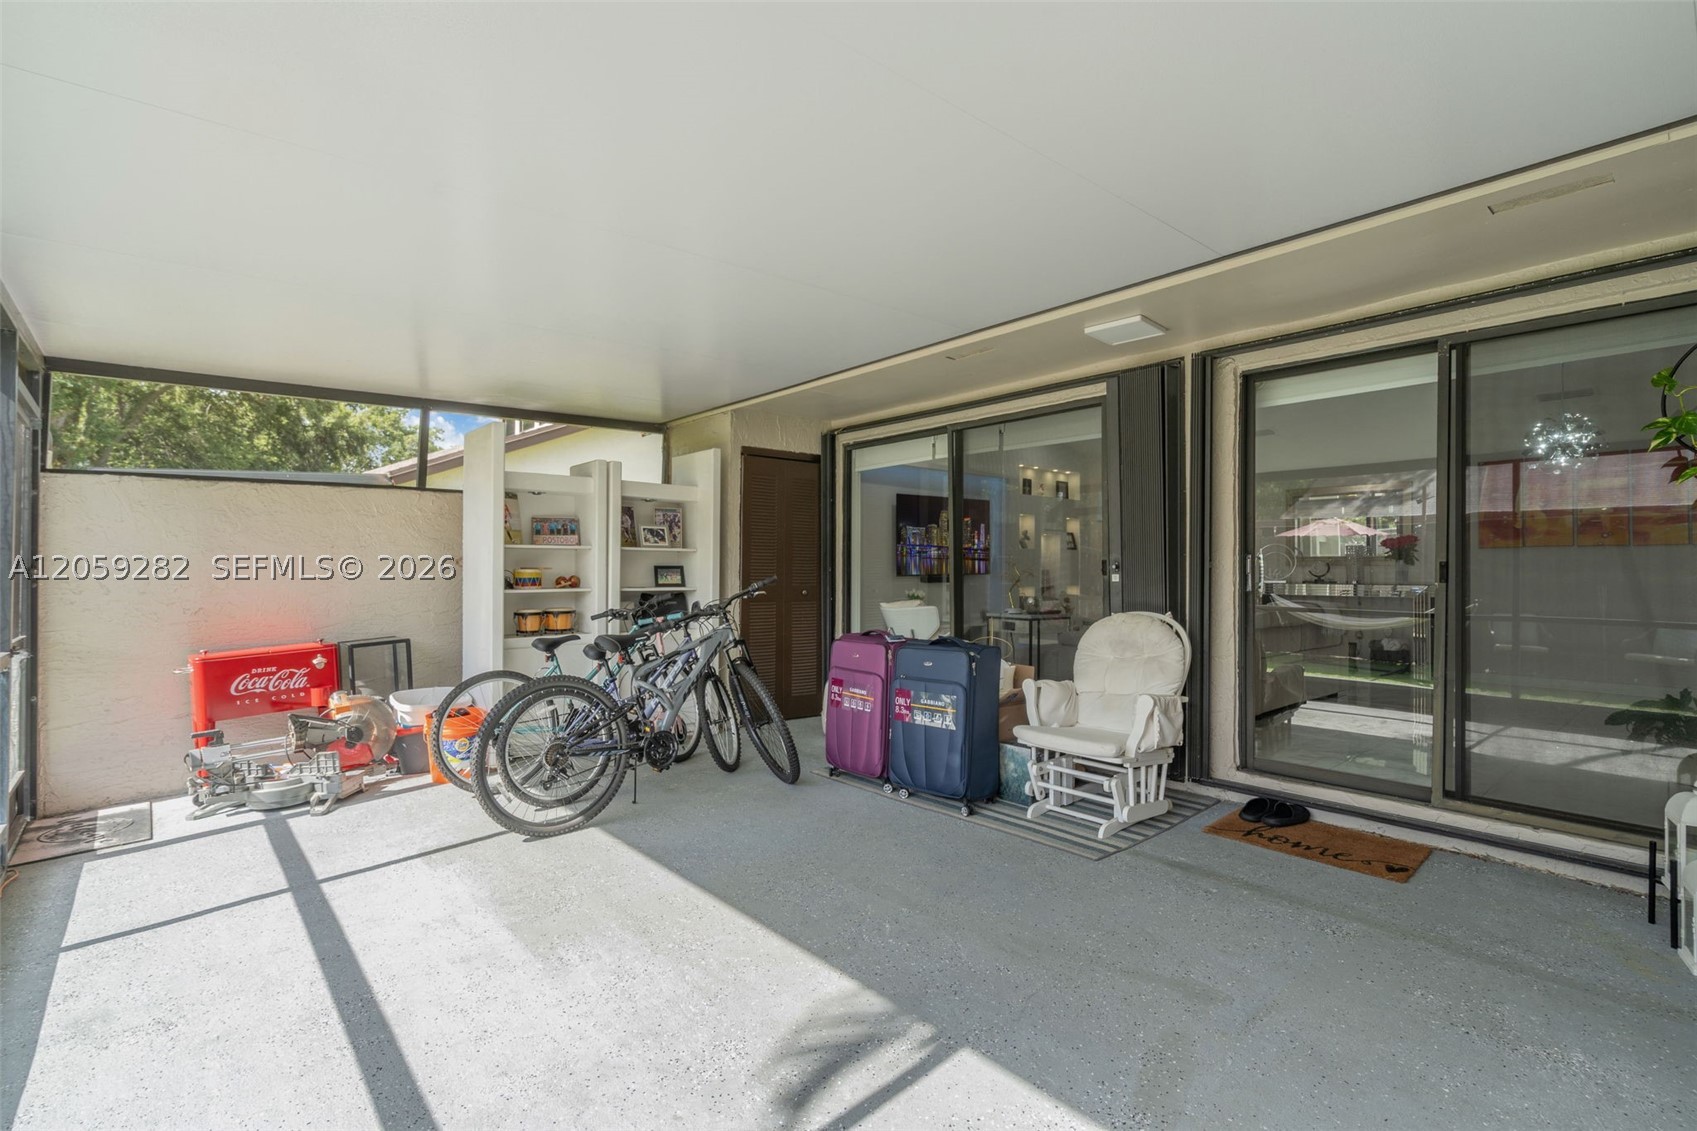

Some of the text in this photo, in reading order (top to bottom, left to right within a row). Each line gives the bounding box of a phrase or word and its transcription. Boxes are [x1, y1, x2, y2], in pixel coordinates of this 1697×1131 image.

[251, 666, 278, 674] DRINK
[230, 667, 311, 696] Coca-Cola
[271, 692, 305, 701] COLD
[895, 696, 911, 706] ONLY
[1238, 825, 1372, 866] home
